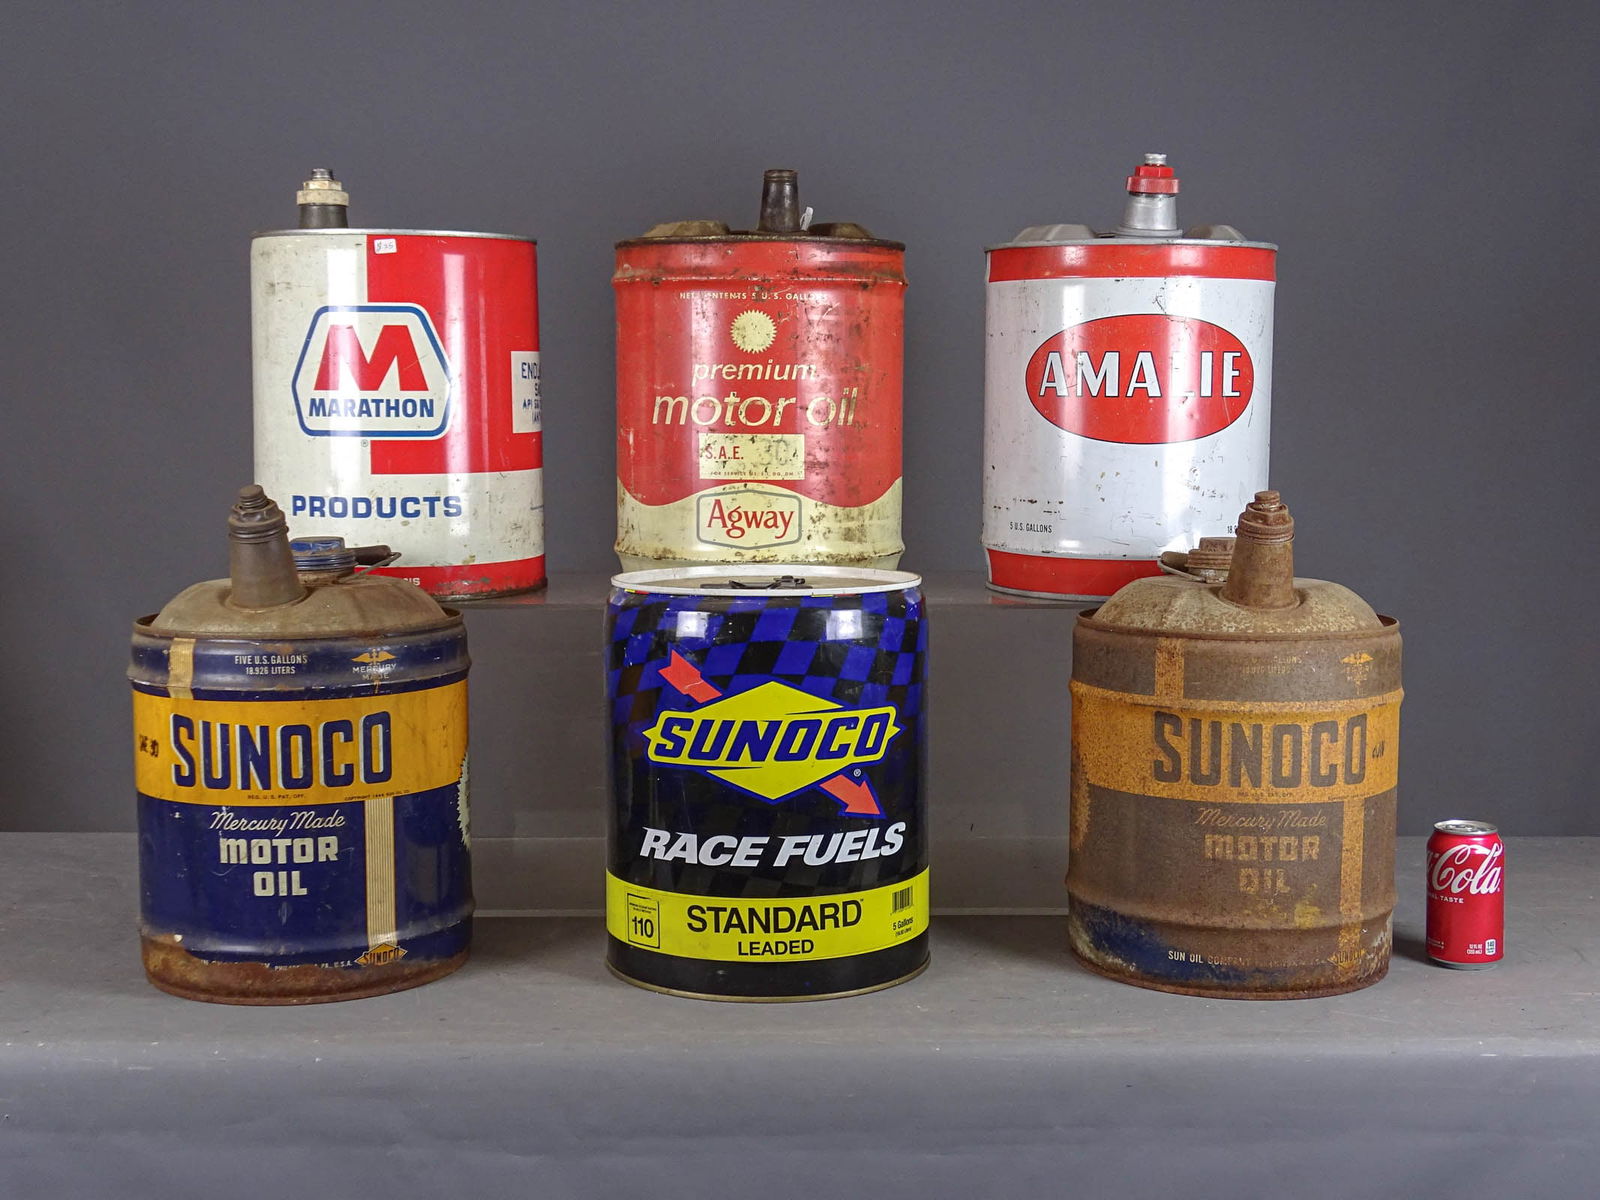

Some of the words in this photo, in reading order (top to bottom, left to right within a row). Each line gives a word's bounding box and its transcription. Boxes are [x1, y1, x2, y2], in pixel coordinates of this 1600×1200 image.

[314, 324, 429, 391] M
[692, 359, 817, 388] premium
[308, 397, 434, 418] MARATHON
[652, 391, 797, 427] motor
[806, 387, 859, 427] oil
[291, 494, 463, 519] PRODUCTS
[707, 499, 795, 539] Agway
[1009, 521, 1014, 530] 5
[1026, 523, 1053, 533] GALLONS
[235, 655, 252, 665] FIVE
[254, 655, 270, 665] U.S.
[271, 654, 308, 665] GALLONS
[271, 666, 296, 675] LITERS
[352, 663, 397, 674] MERCURY
[170, 710, 392, 791] SUNOCO
[653, 715, 892, 762] SUNOCO
[1153, 711, 1368, 789] SUNOCO
[209, 810, 290, 836] Mercury
[290, 811, 345, 829] Made
[1194, 808, 1275, 833] Mercury
[1277, 809, 1327, 828] Made
[219, 835, 339, 864] MOTOR
[640, 826, 771, 867] RACE
[773, 821, 906, 867] FUELS
[1239, 868, 1291, 896] OIL
[1432, 843, 1503, 895] Cola
[253, 871, 308, 897] OIL
[1440, 895, 1464, 904] TASTE
[632, 916, 654, 938] 110
[686, 903, 862, 934] STANDARD
[892, 922, 897, 931] 5
[363, 946, 400, 966] SUNOCO
[737, 939, 815, 957] LEADED
[1168, 950, 1186, 962] SUN
[1189, 952, 1204, 965] OIL
